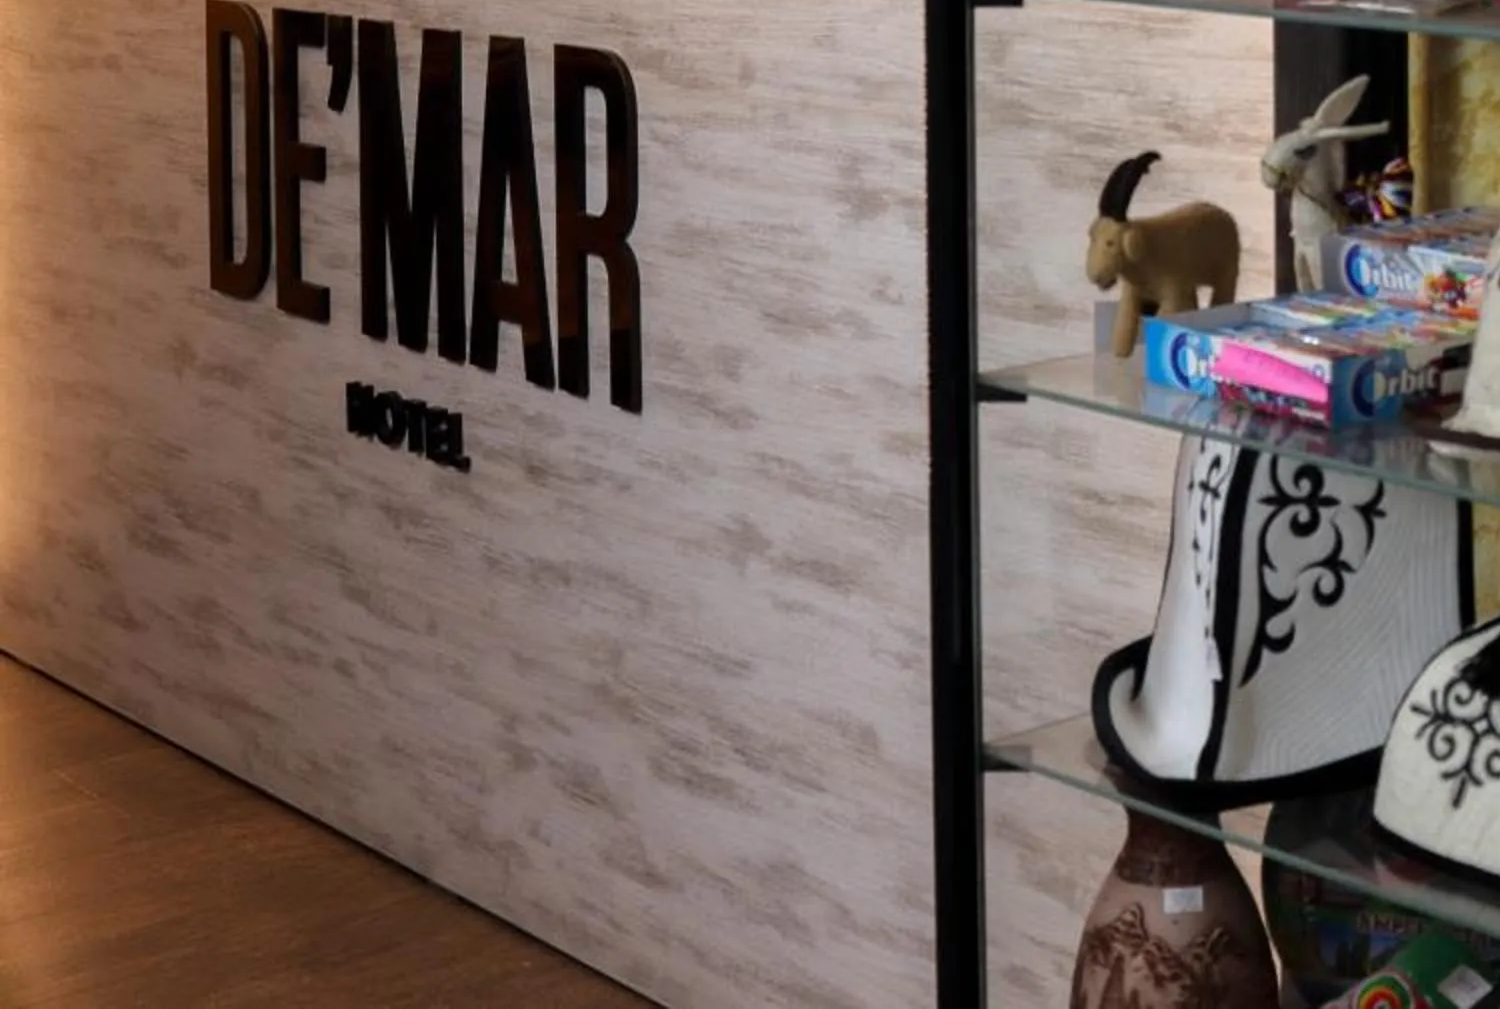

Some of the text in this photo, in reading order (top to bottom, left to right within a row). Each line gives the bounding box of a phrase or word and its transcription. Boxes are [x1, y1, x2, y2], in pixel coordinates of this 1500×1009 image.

[1343, 243, 1413, 295] Orbit
[1352, 358, 1440, 417] Orbit
[345, 380, 472, 474] HOTEL
